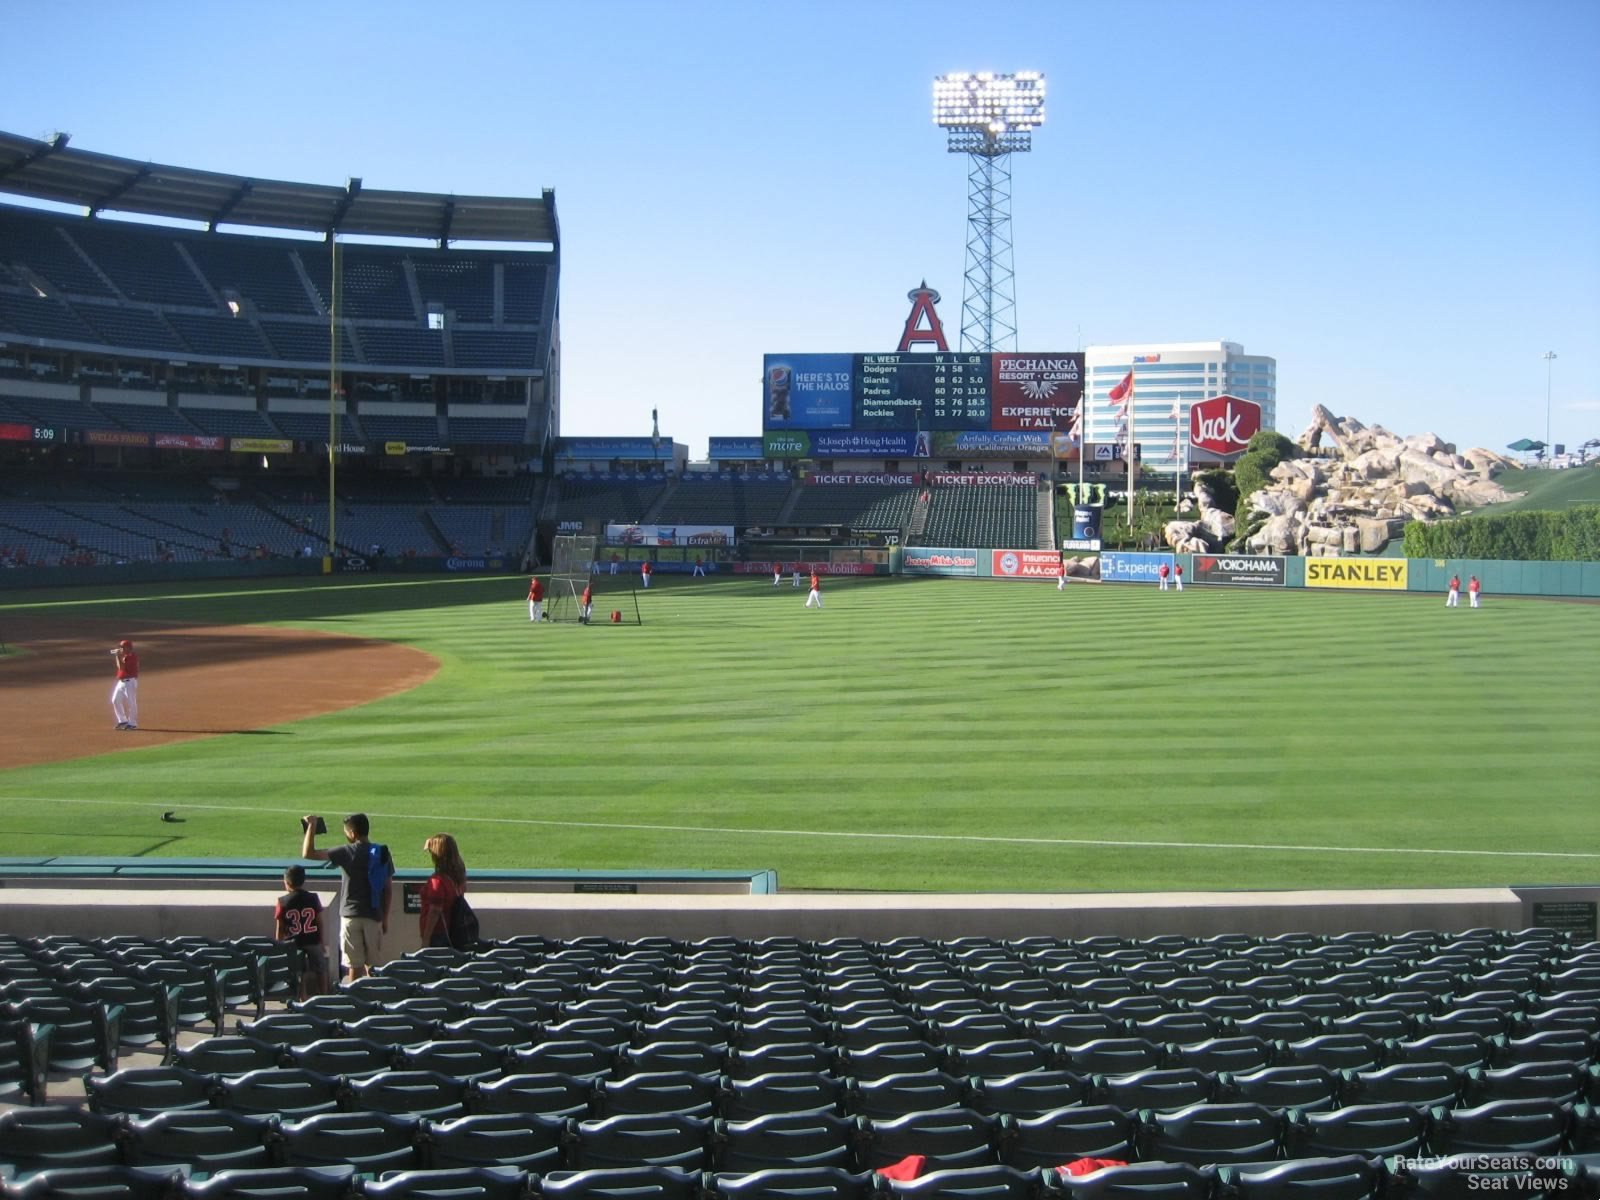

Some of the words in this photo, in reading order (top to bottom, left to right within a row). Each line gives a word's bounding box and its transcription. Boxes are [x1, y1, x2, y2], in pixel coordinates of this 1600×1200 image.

[863, 355, 875, 363] NL
[877, 355, 901, 363] WEST
[935, 355, 944, 363] W
[953, 355, 959, 363] L
[968, 355, 981, 363] GB
[863, 365, 897, 374] Dodgers
[935, 365, 946, 373] 74
[952, 365, 963, 373] 58
[1000, 359, 1078, 371] PECHANGA
[795, 372, 833, 382] HERE'S
[834, 372, 850, 382] TO
[863, 376, 889, 384] Giants
[935, 376, 946, 384] 68
[951, 376, 963, 384] 62
[969, 376, 984, 384] 5.0
[999, 372, 1035, 380] RESORT
[1043, 372, 1078, 380] CASINO
[796, 382, 815, 391] THE
[816, 382, 850, 391] HALOS
[863, 387, 891, 395] Padres
[935, 387, 946, 395] 60
[951, 387, 963, 395] 70
[967, 387, 986, 395] 13.0
[863, 398, 922, 406] Diamondbacks
[935, 398, 946, 406] 55
[951, 398, 963, 406] 76
[967, 398, 985, 406] 18.5
[863, 409, 895, 417] Rockies
[935, 409, 946, 417] 53
[951, 409, 963, 417] 77
[967, 409, 985, 417] 20.0
[1020, 417, 1032, 427] IT
[1192, 401, 1258, 444] Jack
[34, 428, 54, 439] 5:09
[90, 432, 119, 442] WELLS
[120, 433, 149, 444] FARGO
[962, 434, 991, 443] Artfully
[993, 434, 1022, 442] Crafted
[1023, 434, 1042, 442] With
[769, 442, 803, 451] more
[860, 436, 881, 447] Hoag
[881, 436, 907, 445] Health
[325, 443, 342, 452] Yrd
[343, 443, 366, 453] House
[978, 443, 1016, 451] California
[1017, 443, 1049, 452] Oranges
[814, 475, 852, 484] TICKET
[854, 475, 913, 484] EXCHANGE
[935, 475, 975, 485] TICKET
[977, 475, 1036, 485] EXCHANGE
[558, 521, 583, 530] JMG
[884, 534, 899, 546] yp
[905, 555, 931, 568] Jersey
[1022, 552, 1061, 562] Insuranc
[446, 556, 485, 570] Corona
[1117, 560, 1160, 574] Experia
[1216, 558, 1278, 571] YOKOHAMA
[1308, 563, 1404, 581] STANLEY
[286, 907, 317, 933] 32
